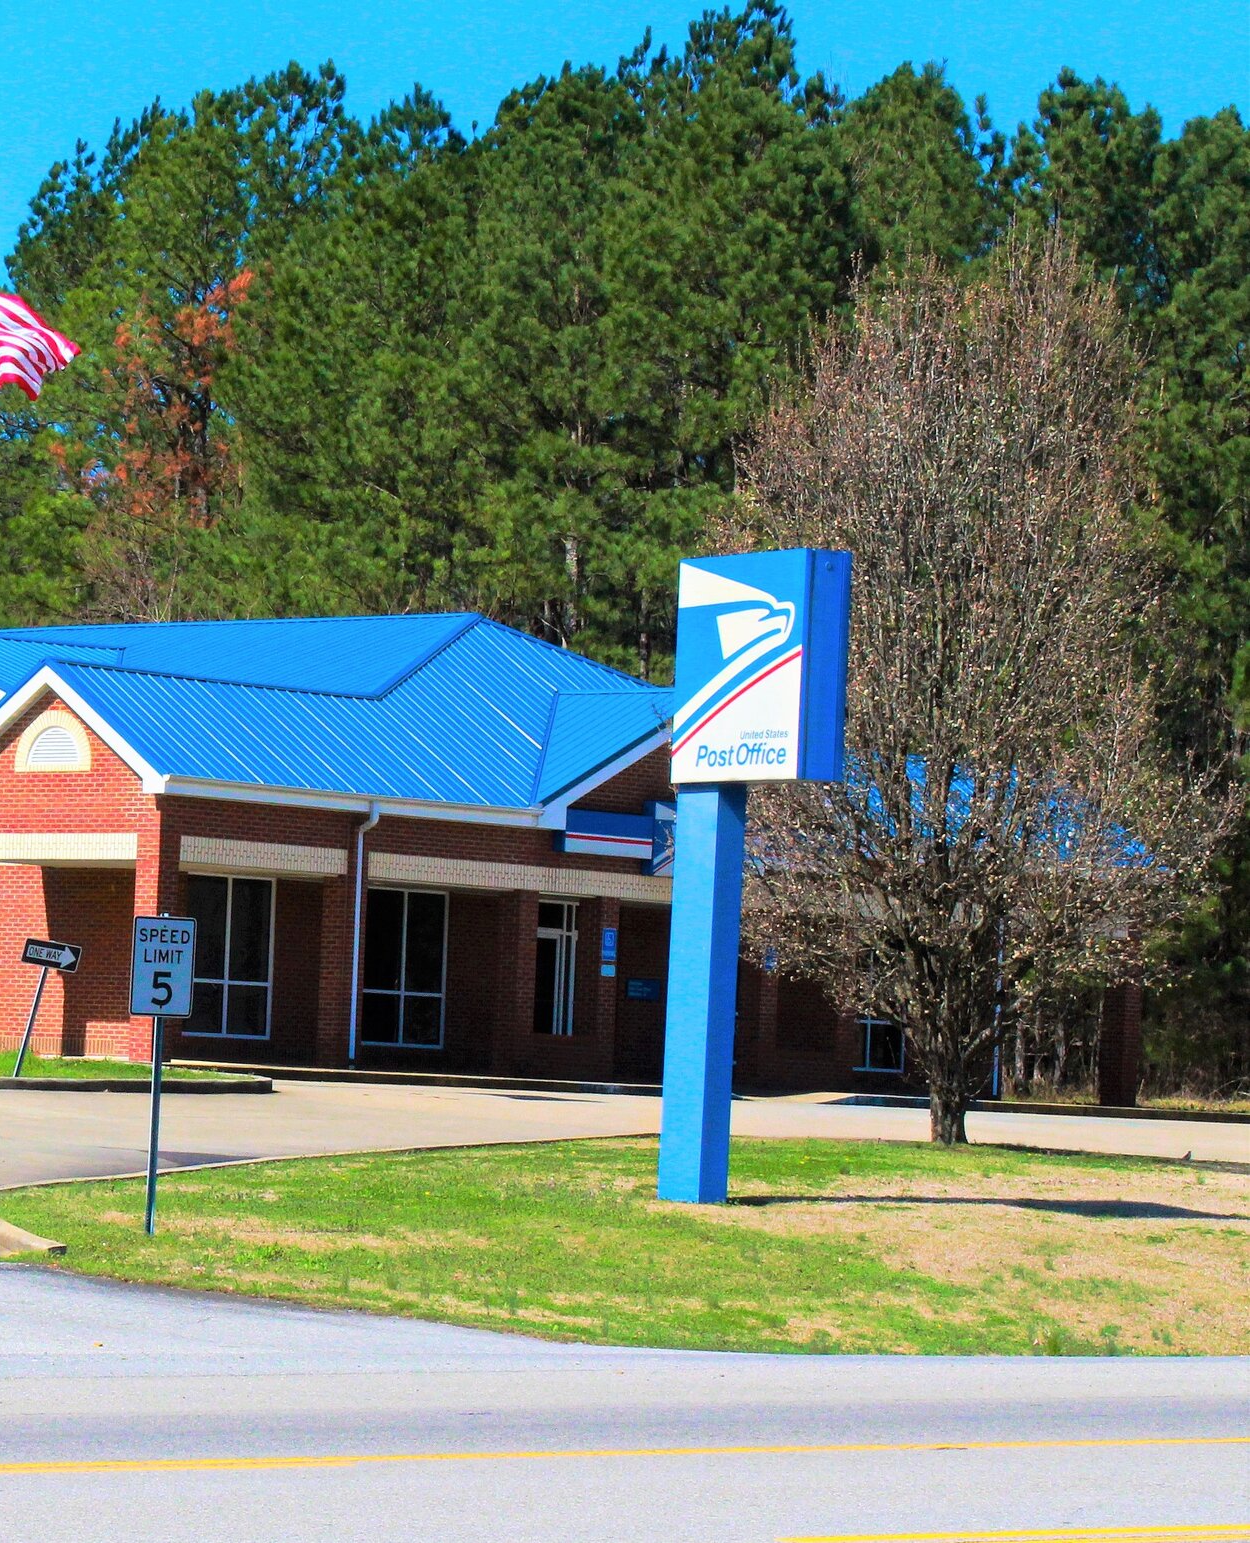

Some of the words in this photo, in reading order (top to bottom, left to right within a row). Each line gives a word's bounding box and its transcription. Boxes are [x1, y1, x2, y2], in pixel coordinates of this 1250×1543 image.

[740, 730, 764, 740] United
[764, 729, 789, 739] States
[695, 744, 734, 768] Post
[736, 742, 787, 766] Office
[139, 928, 190, 944] SPEED
[28, 946, 44, 958] ONE
[45, 949, 63, 961] WAY
[144, 949, 184, 964] LIMIT
[151, 971, 173, 1006] 5
